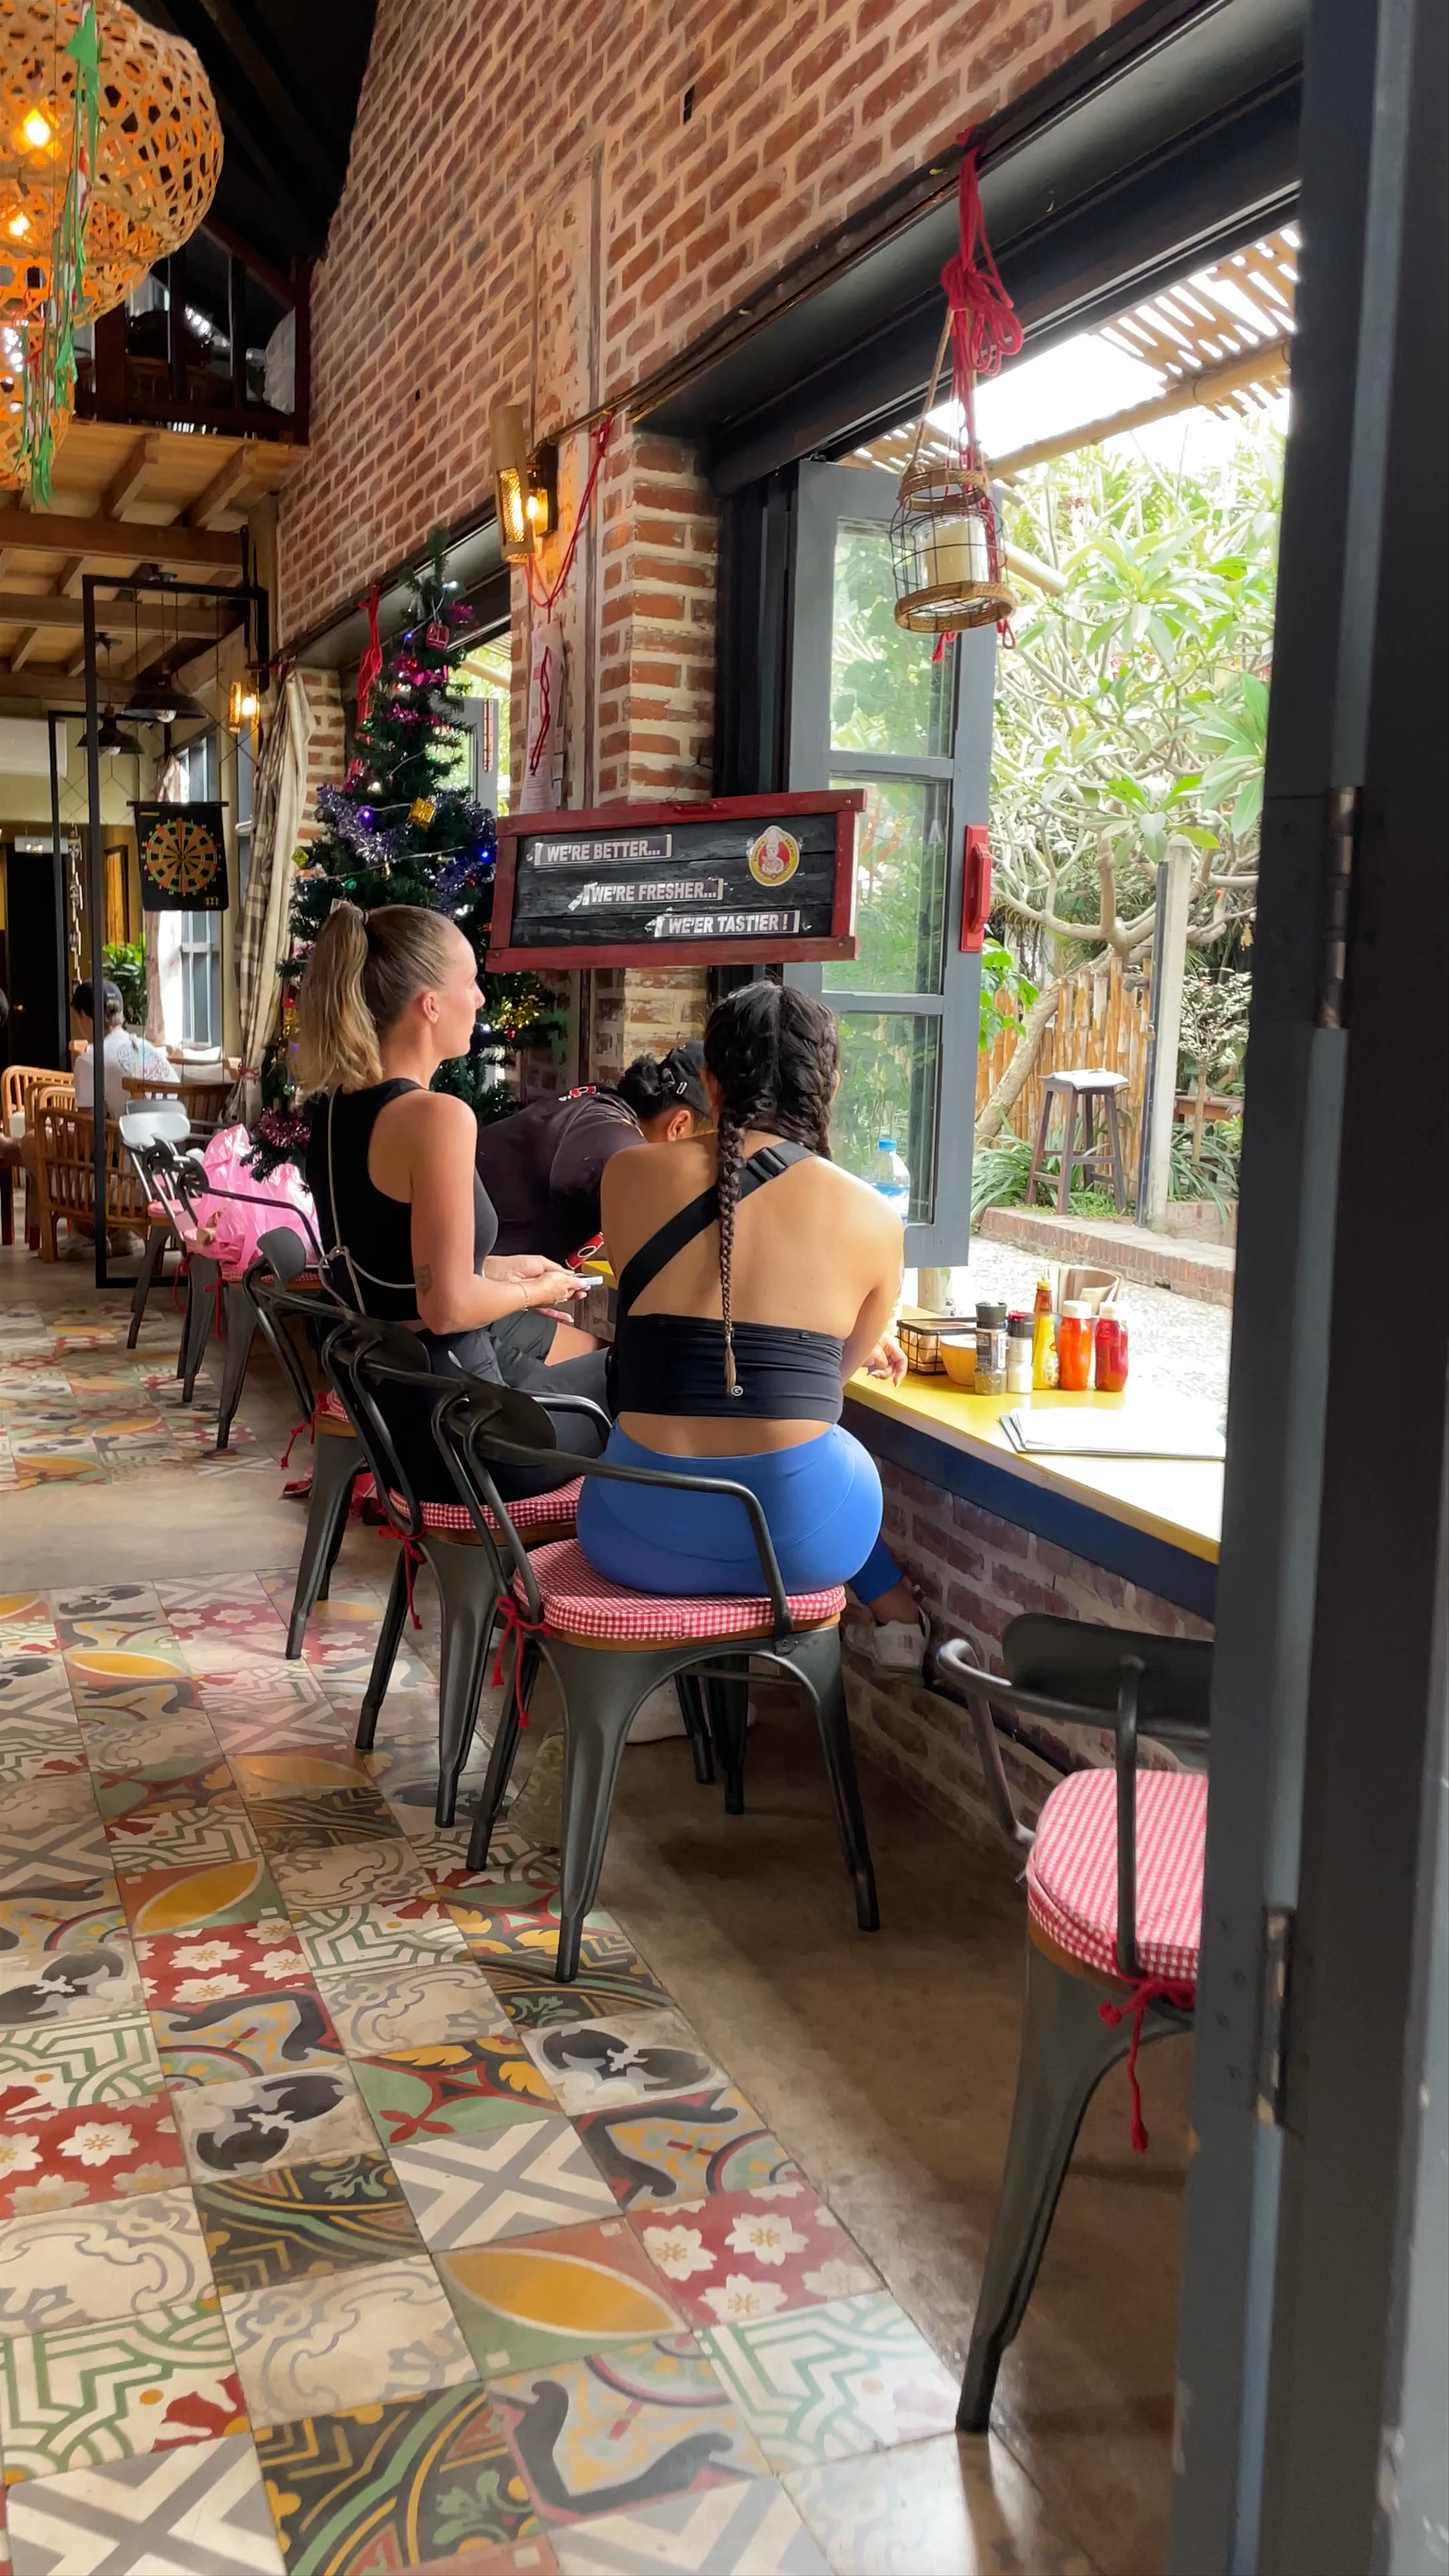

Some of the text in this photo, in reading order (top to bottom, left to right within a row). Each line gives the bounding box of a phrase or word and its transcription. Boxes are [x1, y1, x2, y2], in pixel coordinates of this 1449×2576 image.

[547, 840, 660, 862] WE'RE BETTER...
[591, 881, 717, 903] WE'RE FRESHER...
[669, 916, 714, 934] WE'ER
[717, 914, 778, 932] TASTIER
